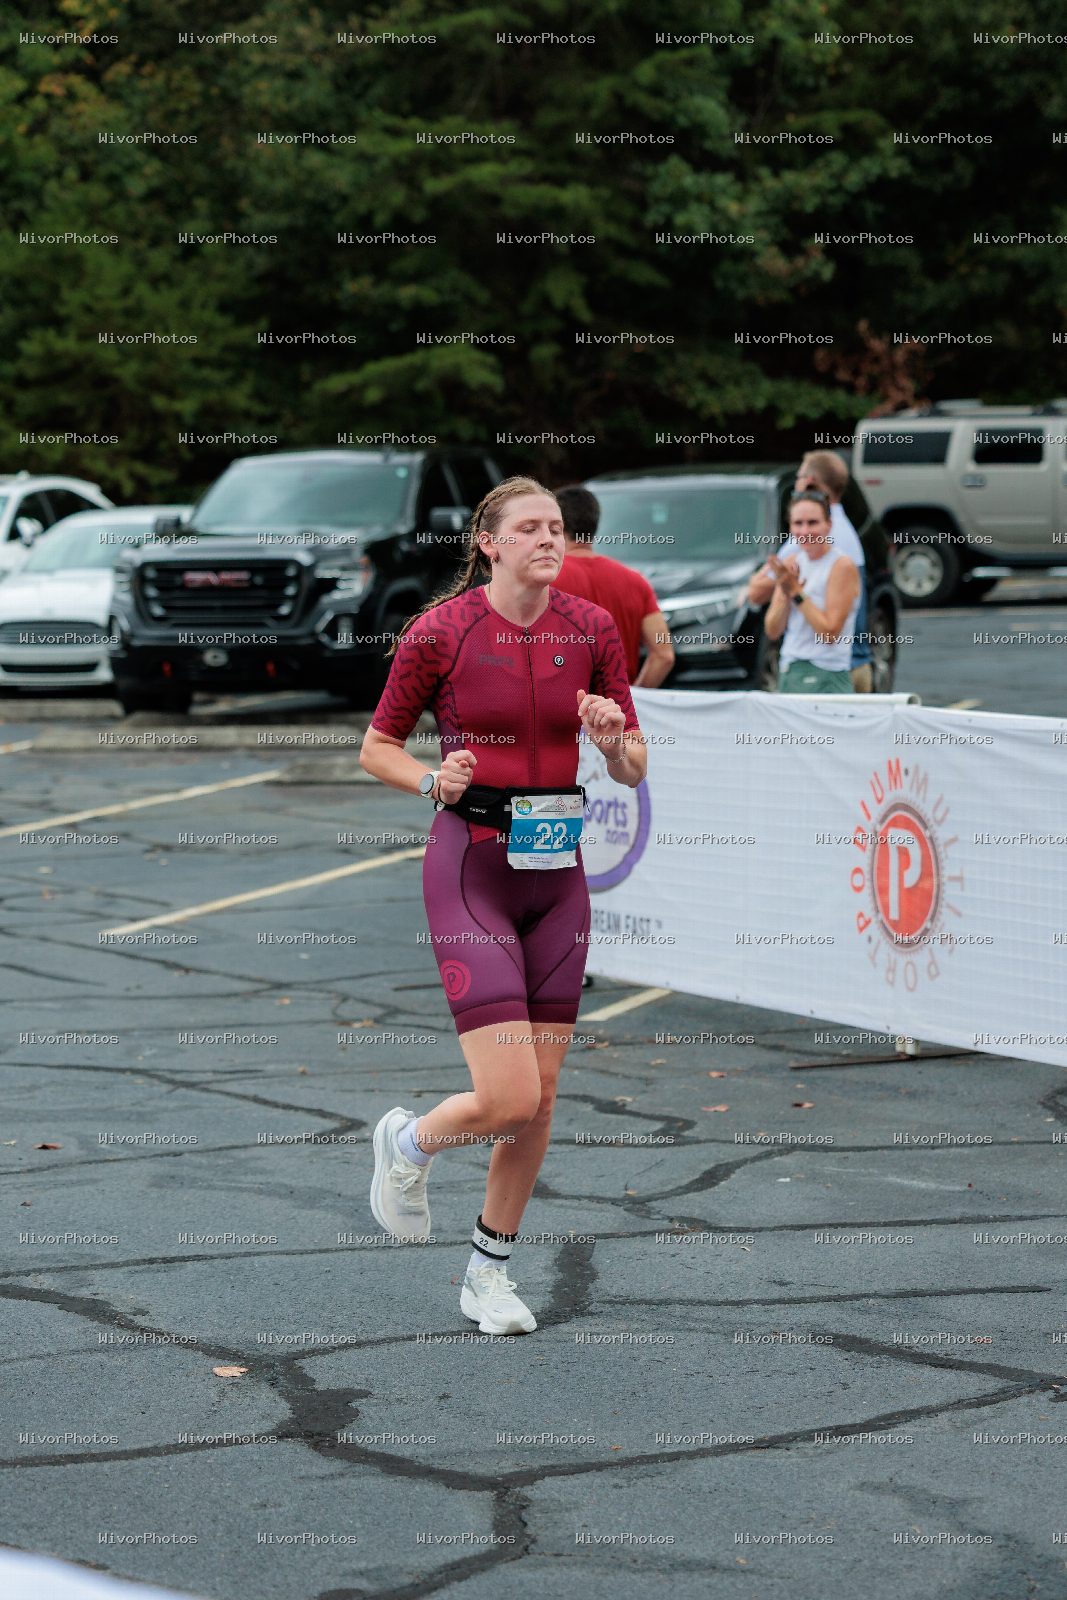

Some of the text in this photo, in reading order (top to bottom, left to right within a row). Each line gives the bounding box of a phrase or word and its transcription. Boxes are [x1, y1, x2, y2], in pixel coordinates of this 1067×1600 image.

[533, 822, 568, 850] 22
[850, 757, 904, 935] PODIUM
[479, 1237, 488, 1248] 22
